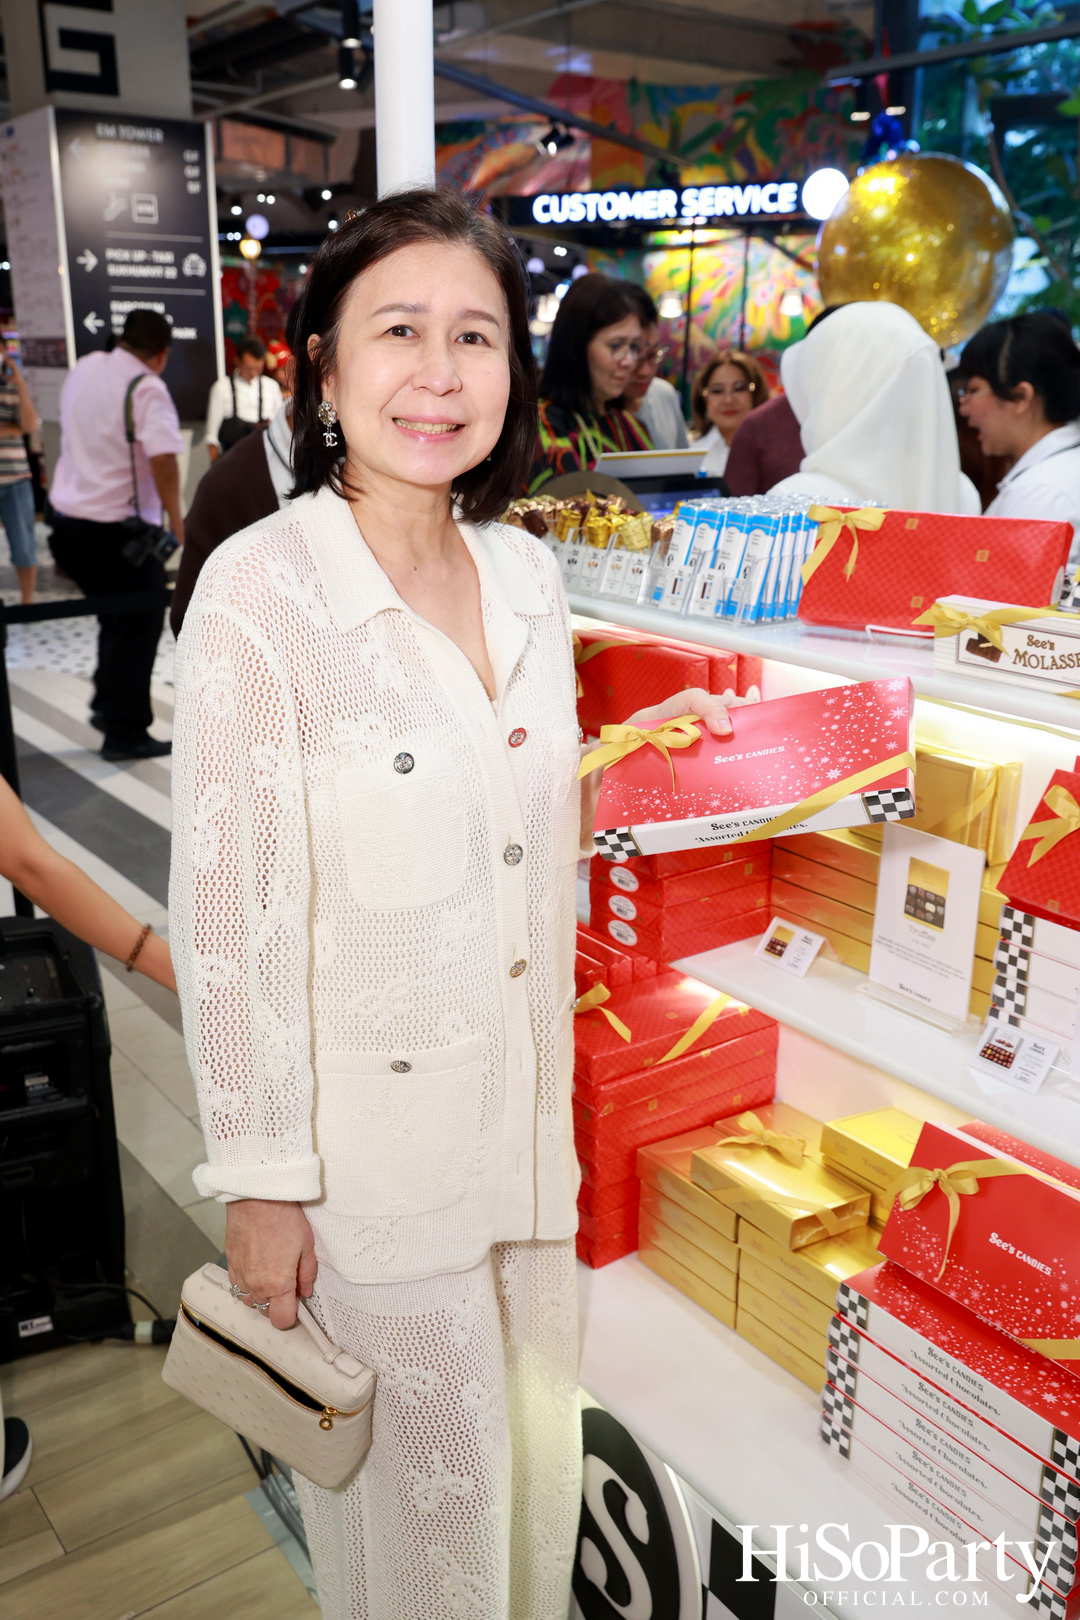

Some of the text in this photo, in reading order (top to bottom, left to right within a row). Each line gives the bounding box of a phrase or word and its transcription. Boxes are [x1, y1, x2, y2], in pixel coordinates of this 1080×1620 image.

[118, 124, 164, 143] TOWER
[532, 182, 798, 223] CUSTOMER SERVICE
[171, 327, 197, 340] PARK
[1026, 634, 1055, 651] See's
[713, 745, 785, 765] See's CANDIES
[710, 821, 741, 831] See's
[988, 1232, 1052, 1276] See's CANDIES
[928, 1347, 984, 1392] See's CANDIES
[918, 1381, 974, 1427] See's CANDIES
[915, 1418, 972, 1465] See's CANDIES
[936, 1470, 968, 1498] CANDIES
